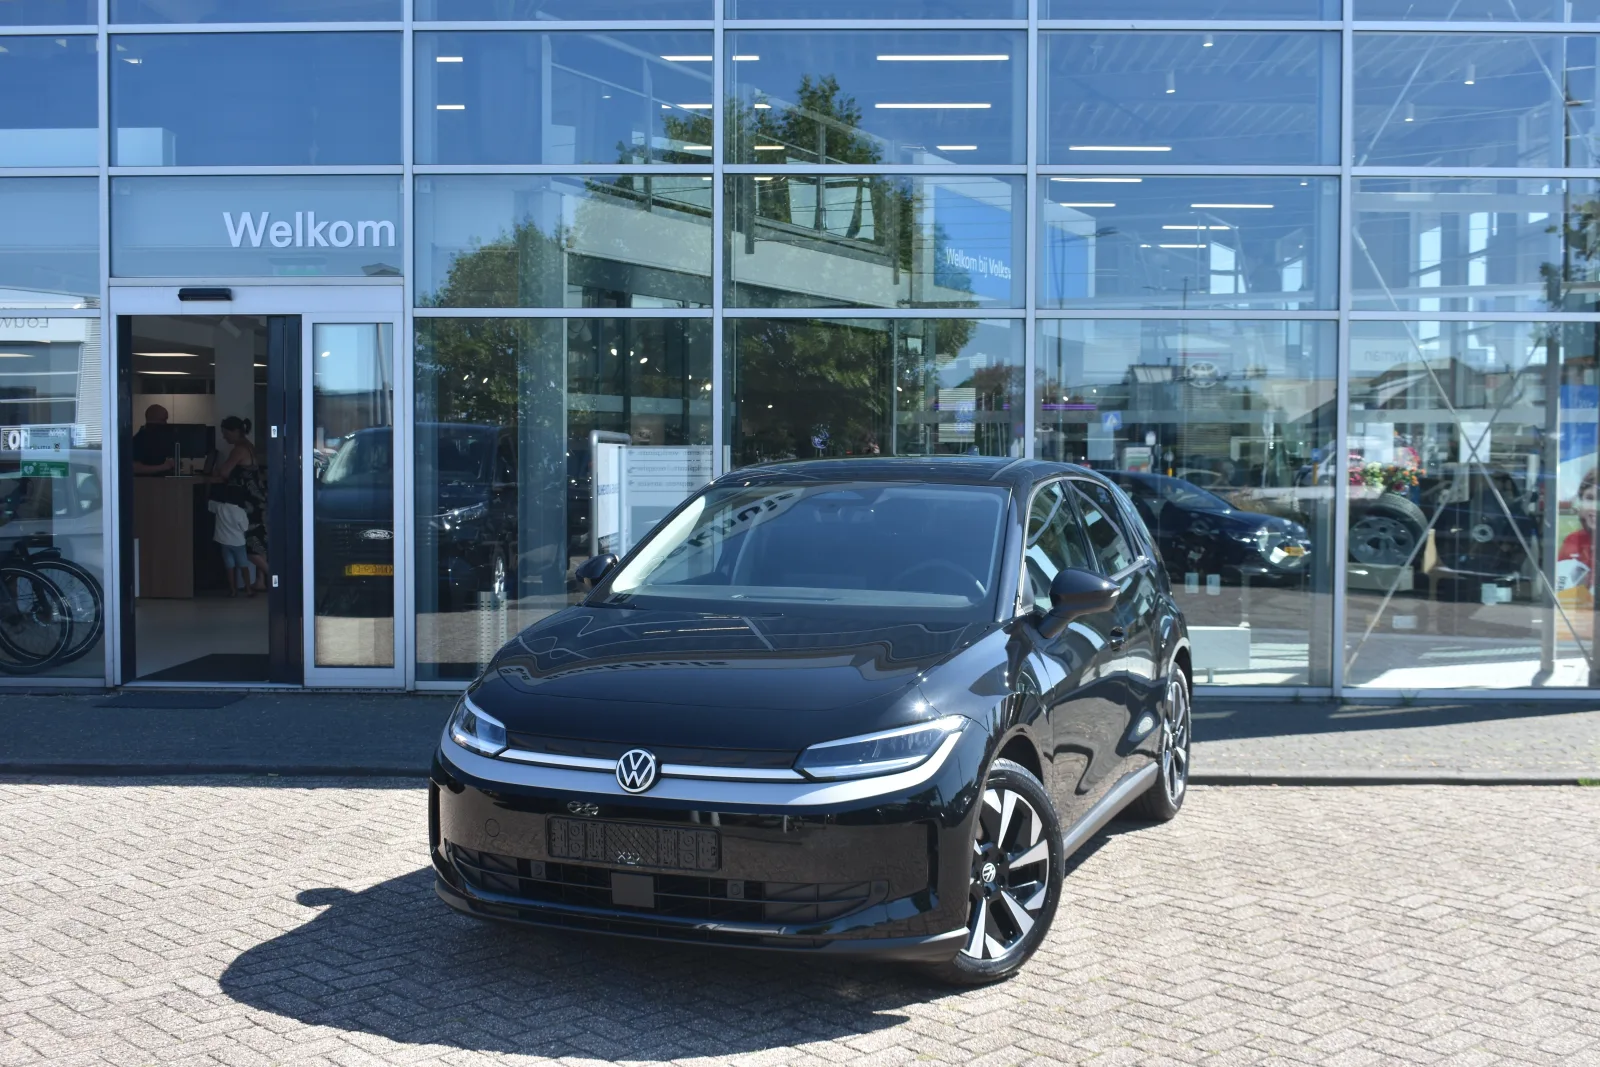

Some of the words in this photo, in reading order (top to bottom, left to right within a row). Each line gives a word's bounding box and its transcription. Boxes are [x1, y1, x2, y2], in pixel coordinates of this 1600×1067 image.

[222, 211, 396, 248] Welkom
[946, 247, 977, 272] Welkom
[978, 255, 988, 278] bij
